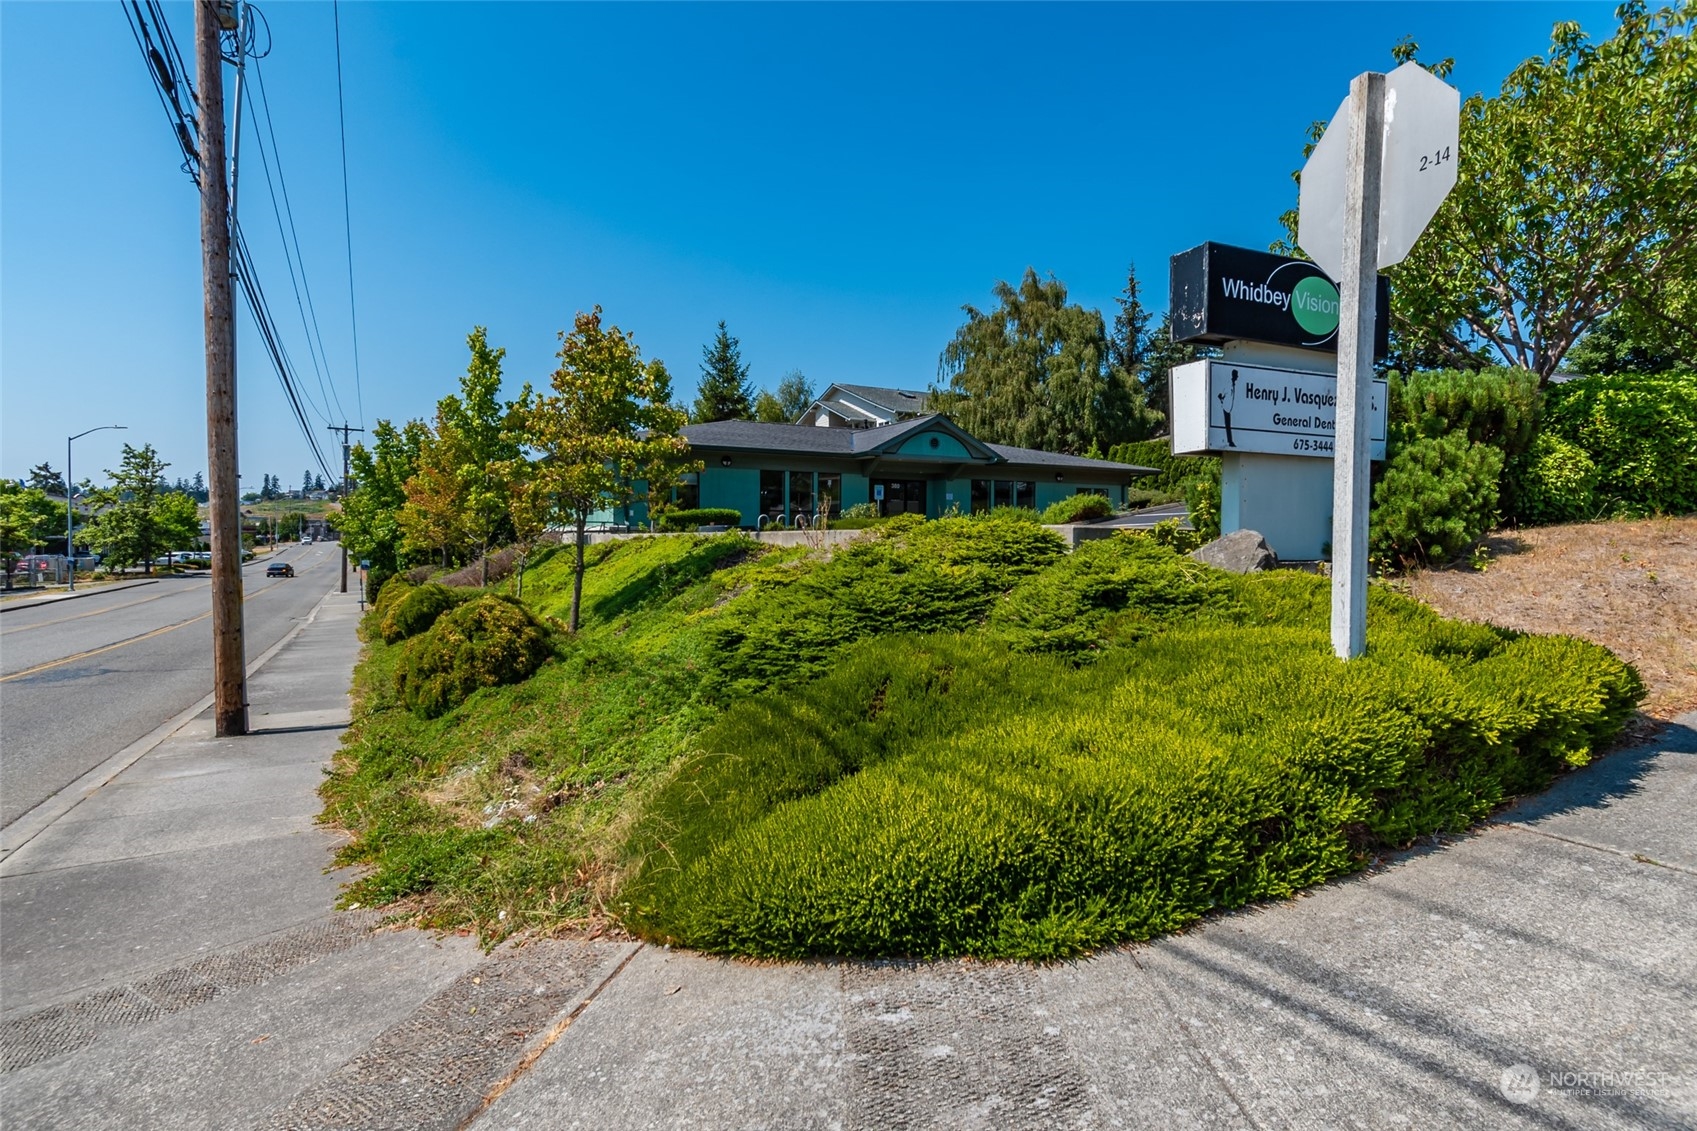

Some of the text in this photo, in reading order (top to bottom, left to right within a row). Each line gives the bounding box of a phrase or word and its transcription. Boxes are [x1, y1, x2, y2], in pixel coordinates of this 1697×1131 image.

[1419, 146, 1450, 171] 2-14
[1222, 277, 1339, 315] Whidbey Vision
[1246, 382, 1278, 405] Henry
[1282, 386, 1291, 402] J.
[1273, 413, 1335, 430] General Dent
[1293, 439, 1333, 452] 675-3444
